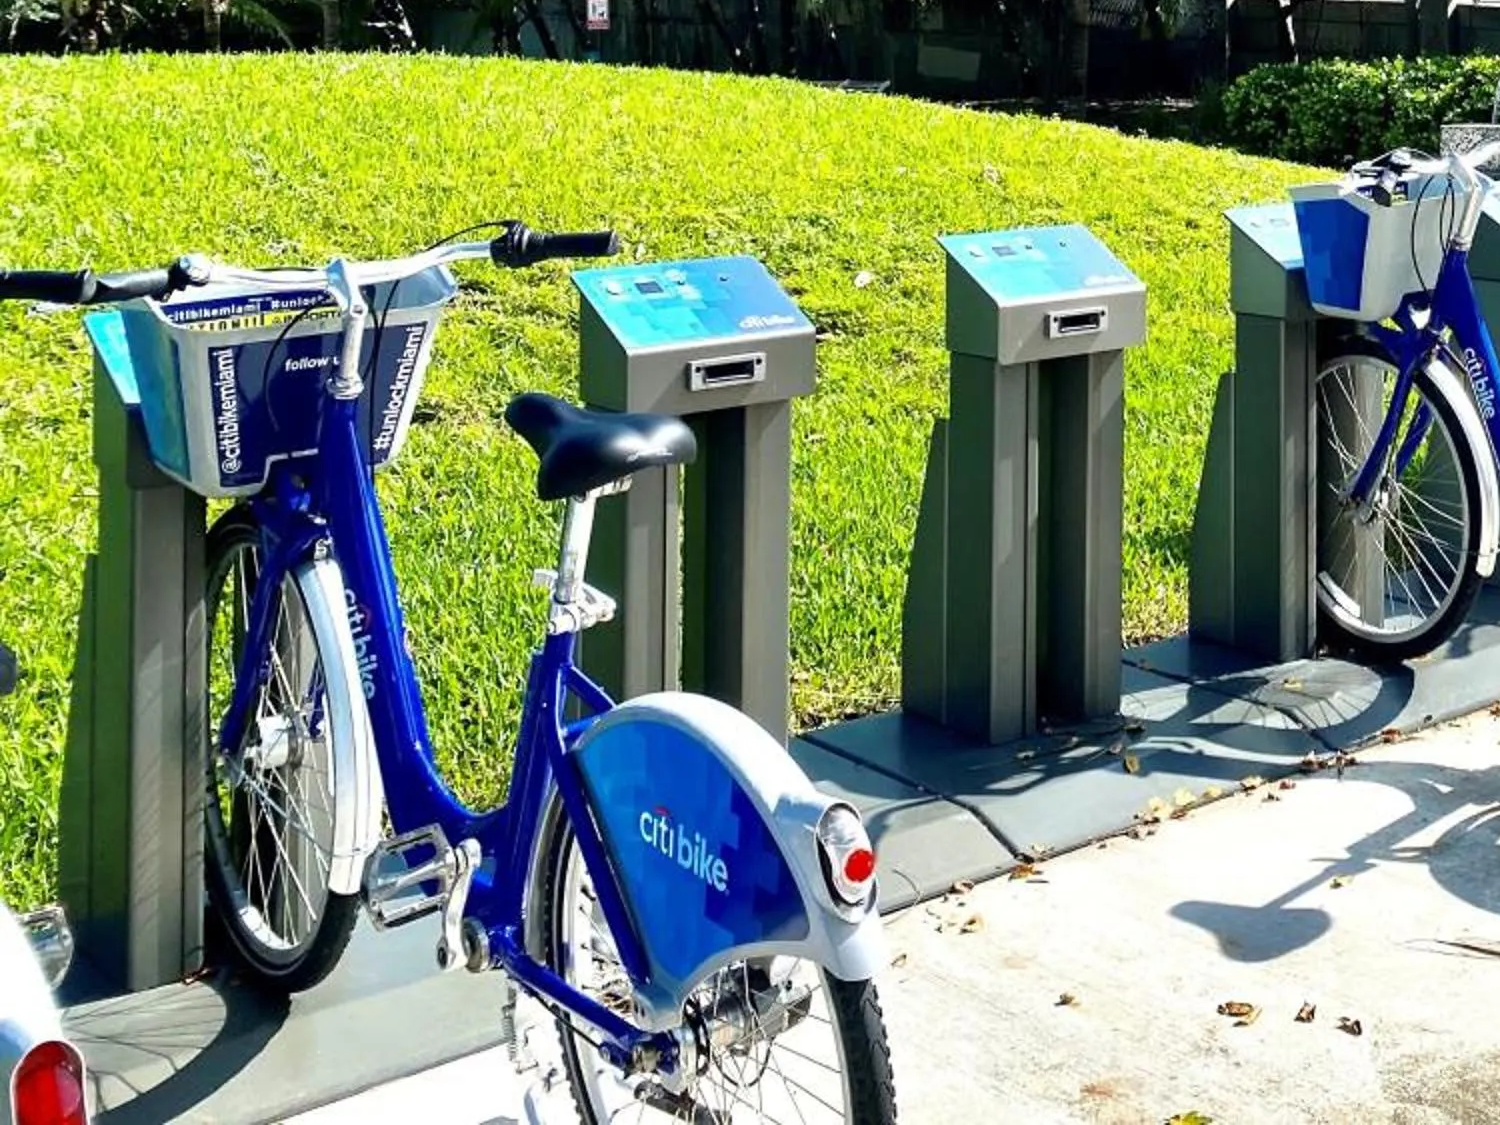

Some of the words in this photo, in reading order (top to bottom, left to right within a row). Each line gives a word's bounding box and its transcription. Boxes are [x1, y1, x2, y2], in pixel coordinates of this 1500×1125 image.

[212, 346, 241, 475] @citibikemiami
[285, 356, 328, 372] follow
[372, 325, 425, 451] #unlockmiami
